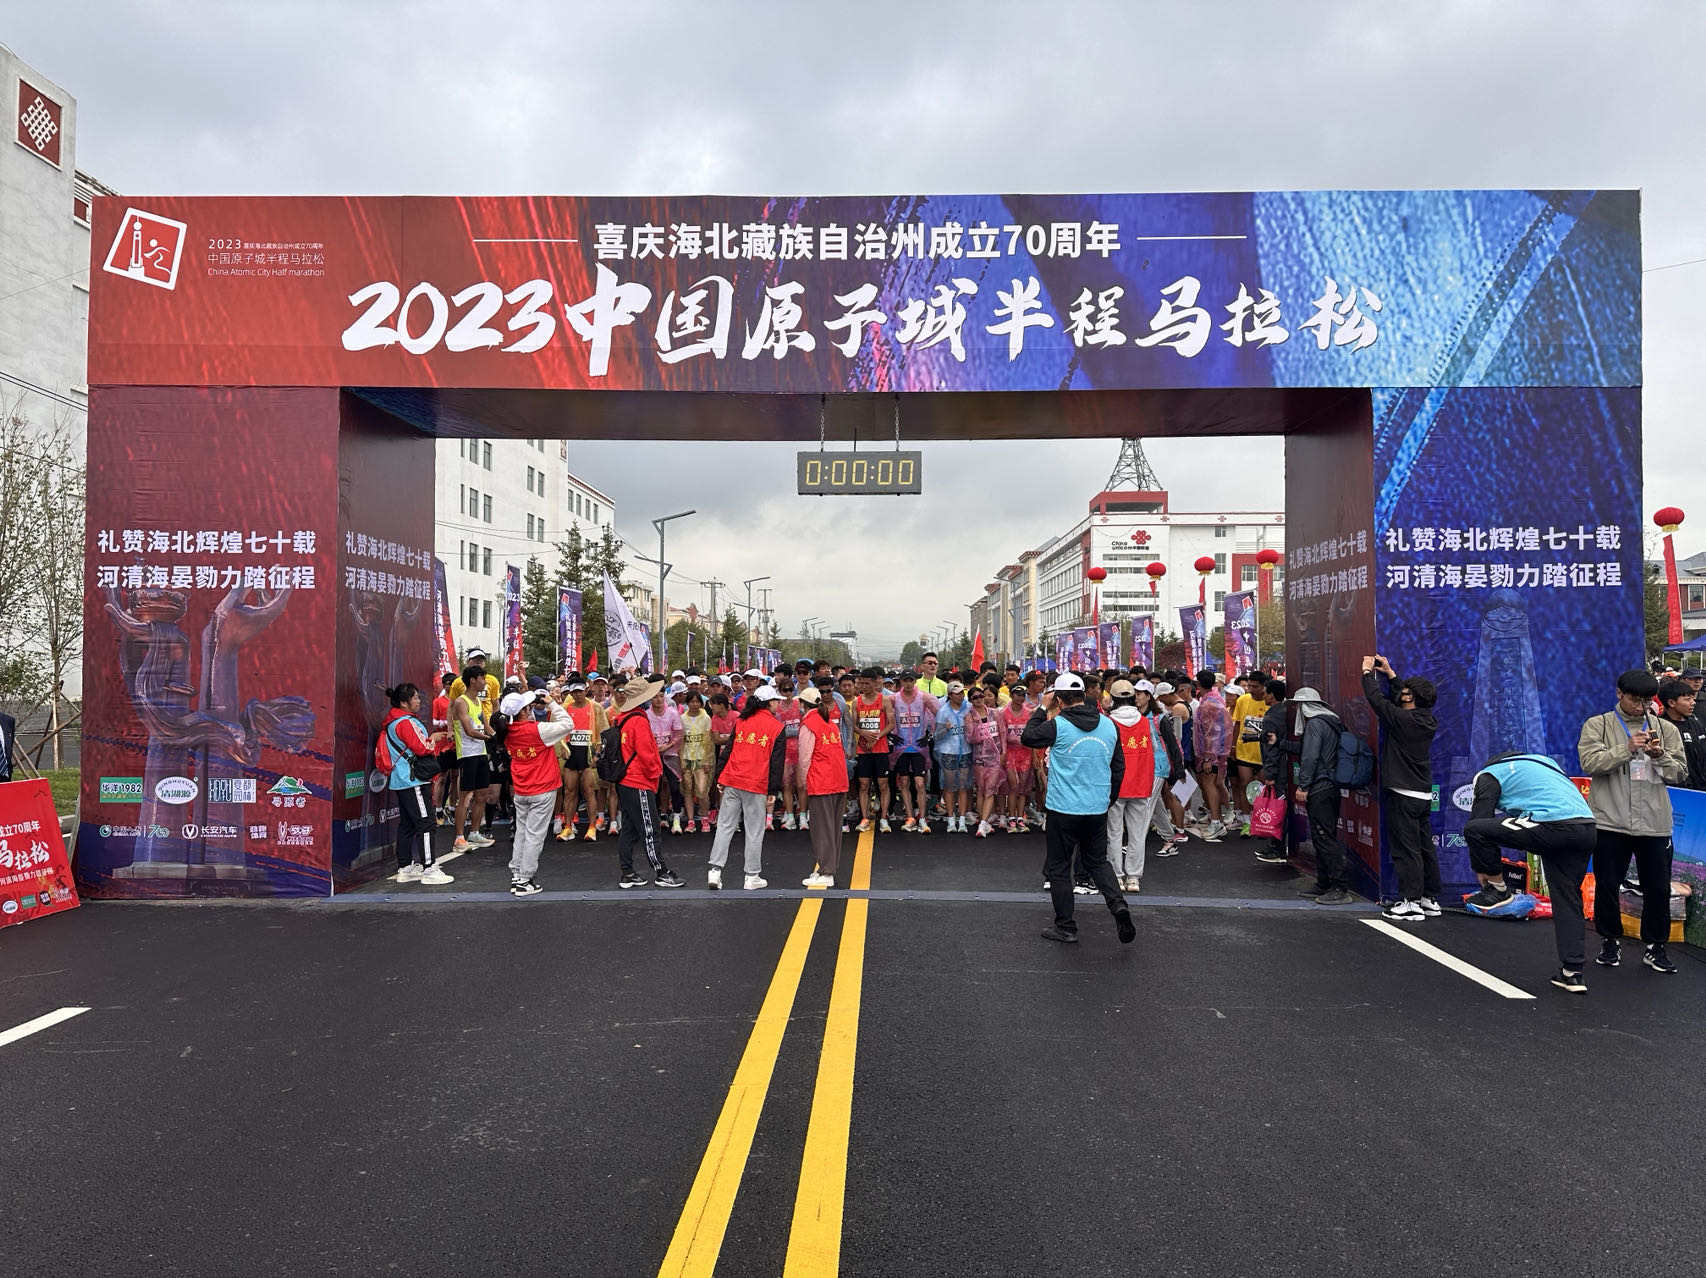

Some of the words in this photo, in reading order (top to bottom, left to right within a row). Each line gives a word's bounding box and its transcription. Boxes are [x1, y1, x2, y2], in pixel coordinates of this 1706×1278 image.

[208, 239, 241, 249] 2023
[594, 222, 1121, 260] 喜庆海北藏族自治州成立70周年
[208, 252, 324, 265] 中国原子城半程马拉松
[207, 268, 229, 276] China
[230, 268, 256, 276] Atomic
[257, 268, 270, 278] City
[271, 268, 287, 276] Half
[288, 268, 325, 276] marathon
[806, 460, 914, 485] 0:00:00
[97, 529, 316, 554] 礼赞海北辉煌七十载
[345, 530, 431, 571] 礼赞海北辉煌七十载
[1385, 525, 1622, 553] 礼赞海北辉煌七十载
[97, 565, 316, 590] 河清海晏勠力踏征程
[1385, 562, 1622, 590] 河清海晏勠力踏征程
[736, 731, 768, 747] 志愿者
[1121, 736, 1149, 749] 愿者
[202, 826, 237, 834] 长安汽车
